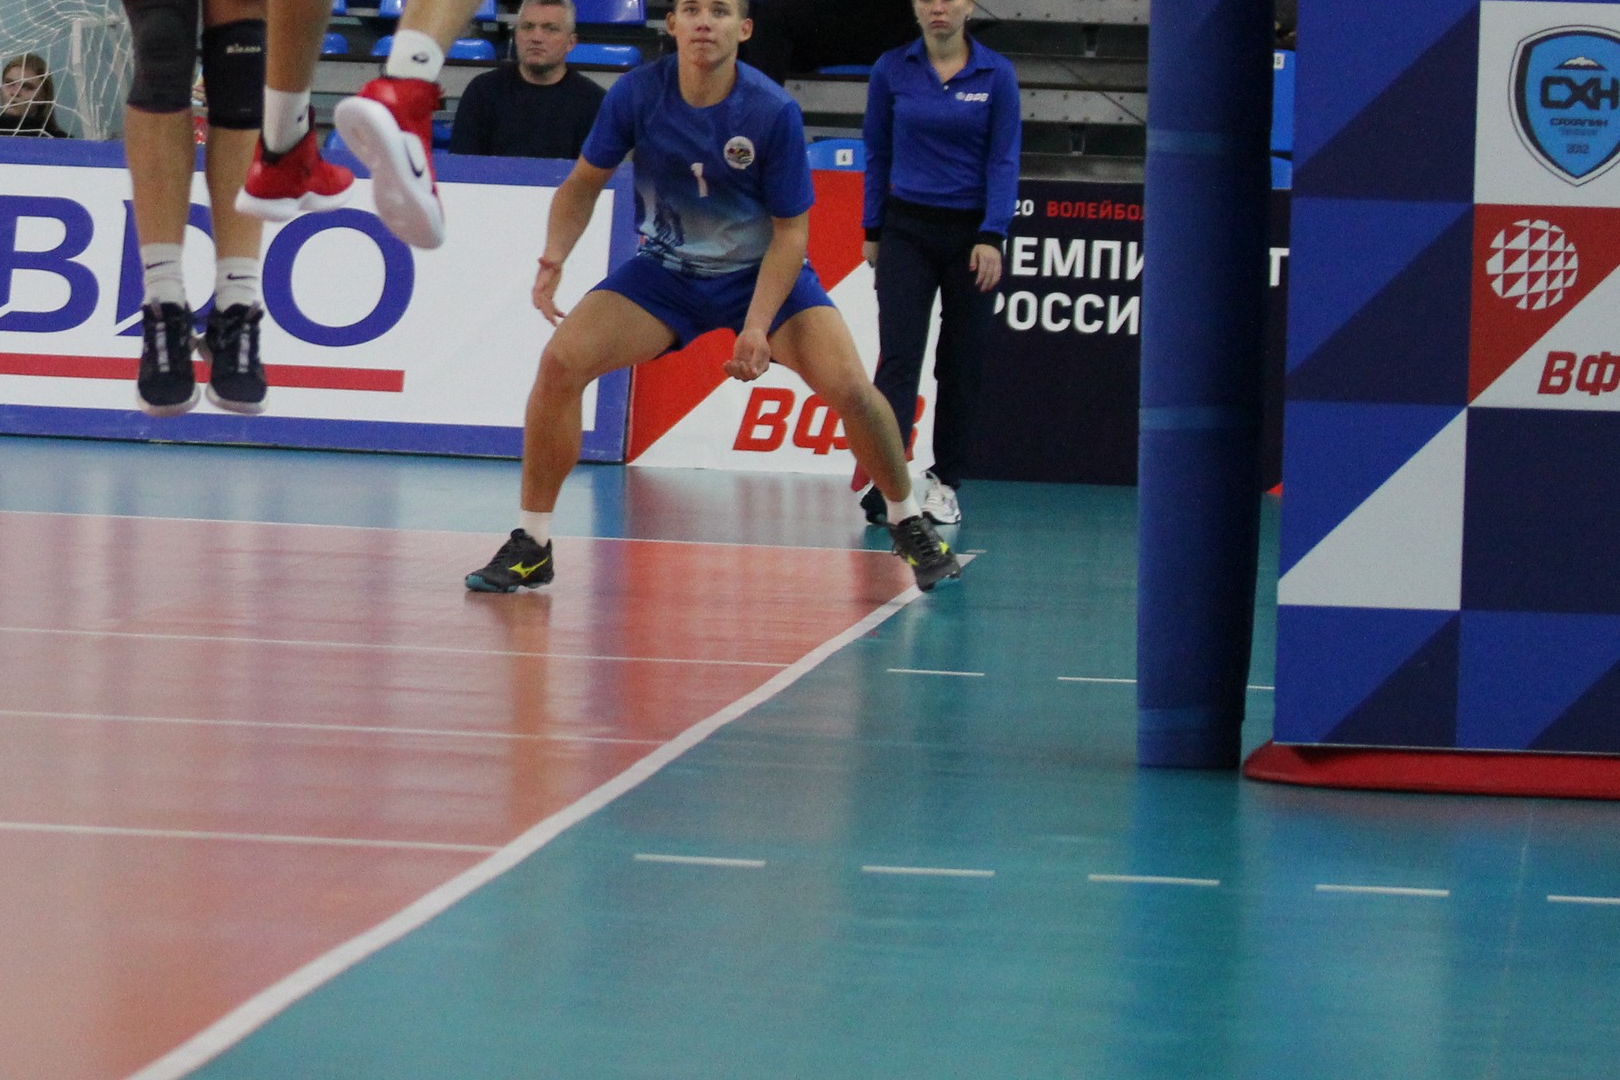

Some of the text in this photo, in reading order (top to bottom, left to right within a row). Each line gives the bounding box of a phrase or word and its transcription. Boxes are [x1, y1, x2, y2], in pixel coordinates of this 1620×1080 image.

[690, 162, 709, 198] 1
[1045, 201, 1145, 221] ВОЛЕЙБО
[731, 386, 926, 462] ВФ
